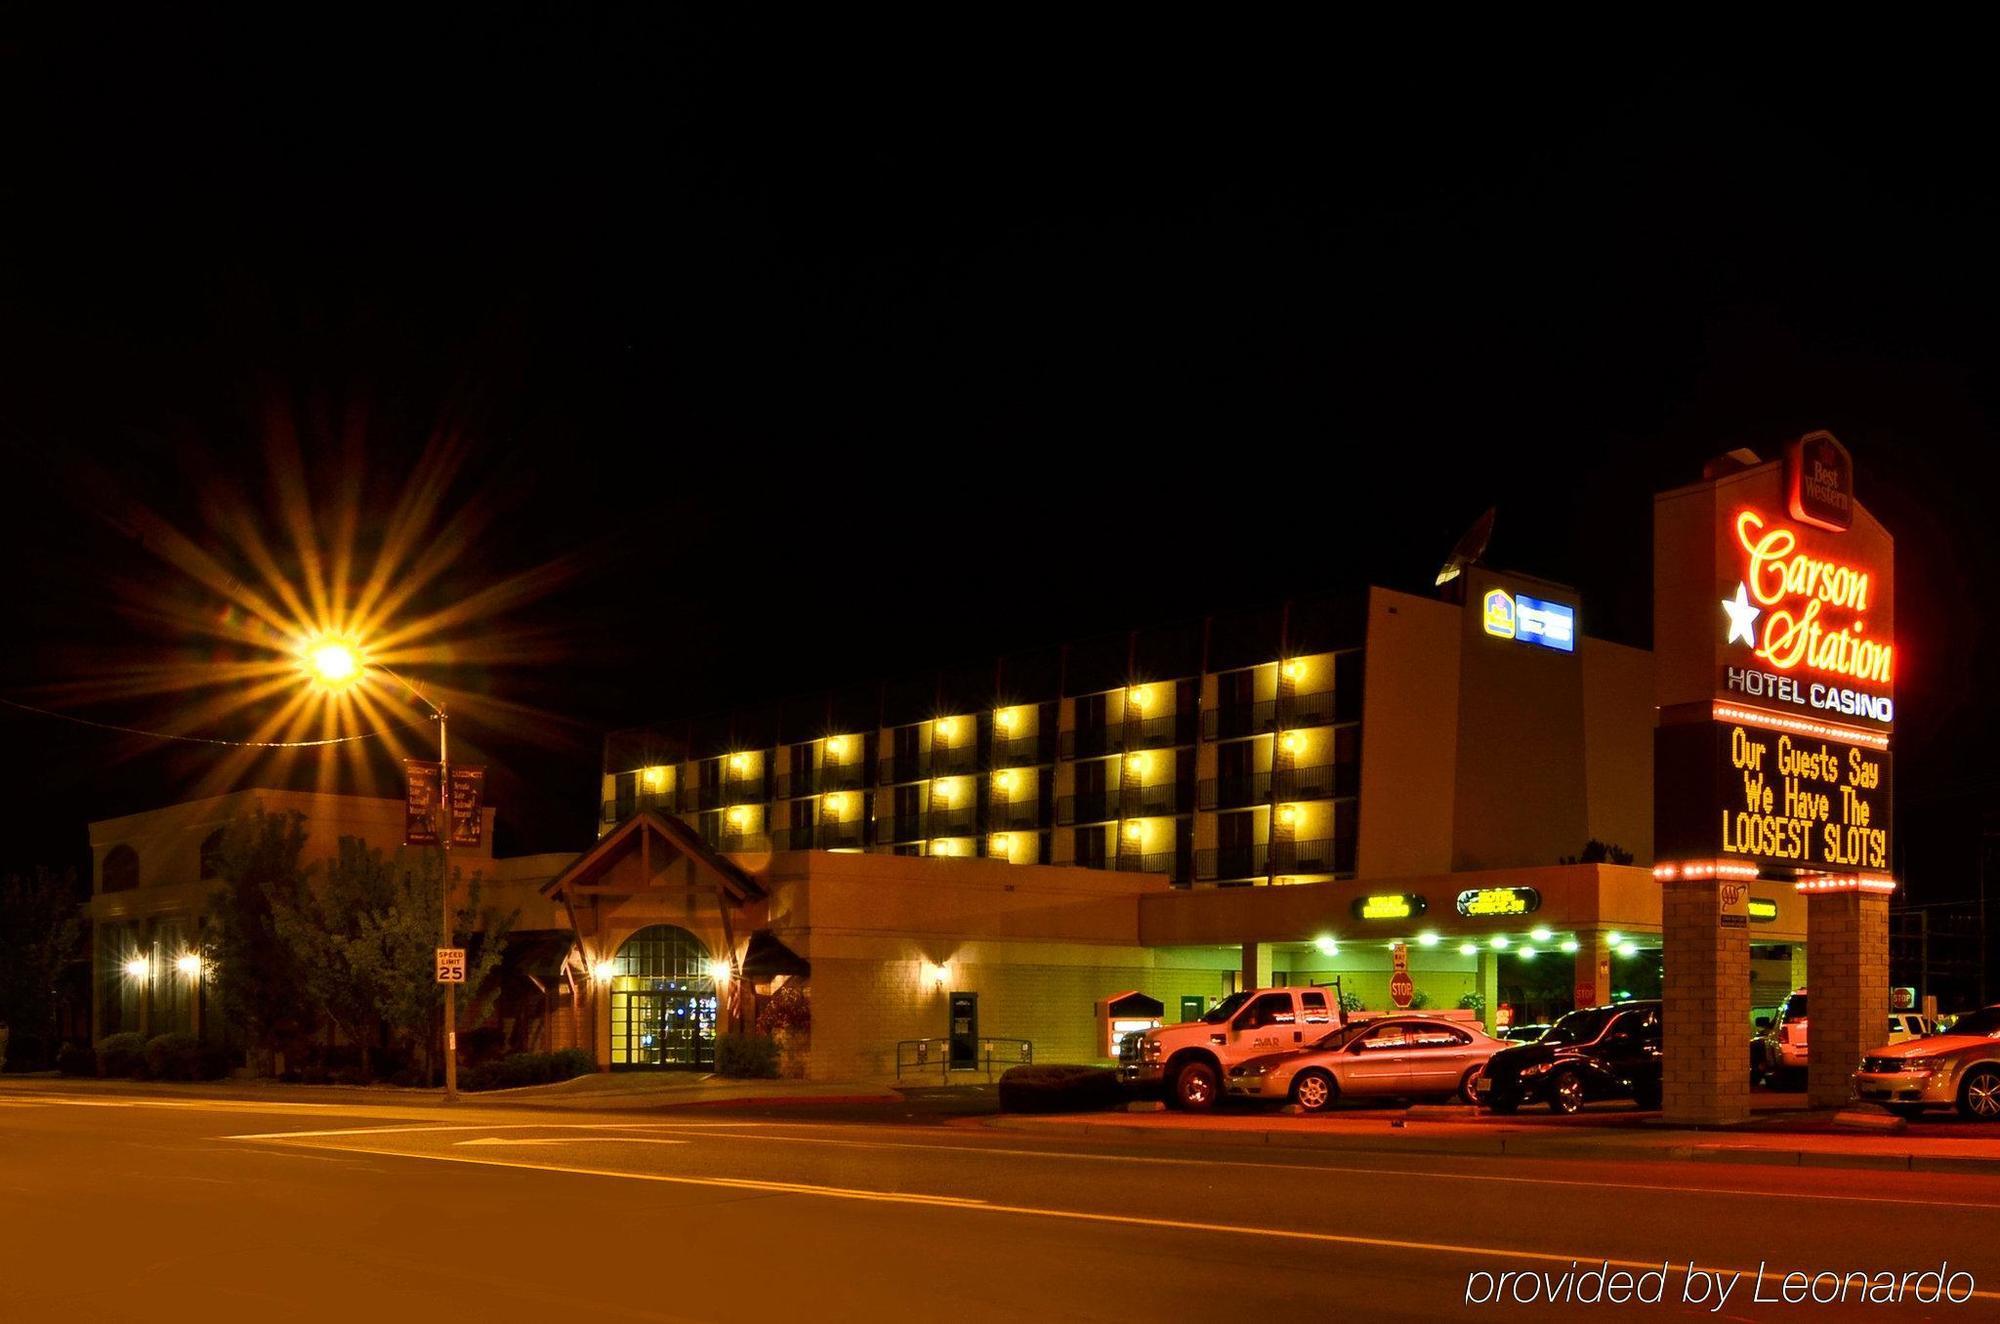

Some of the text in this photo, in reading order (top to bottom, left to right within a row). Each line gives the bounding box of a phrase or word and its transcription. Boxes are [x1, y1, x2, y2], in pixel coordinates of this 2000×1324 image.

[1805, 475, 1848, 510] Western
[1814, 460, 1838, 487] Best
[1736, 510, 1868, 611] Carson
[1754, 597, 1893, 683] Station
[1728, 666, 1894, 722] HOTEL CASINO
[1731, 726, 1879, 789] Our Guests Say
[1744, 770, 1870, 826] We Have The
[1723, 809, 1886, 868] LOOSEST SLOTS!
[439, 967, 462, 980] 25
[1392, 982, 1411, 996] STOP
